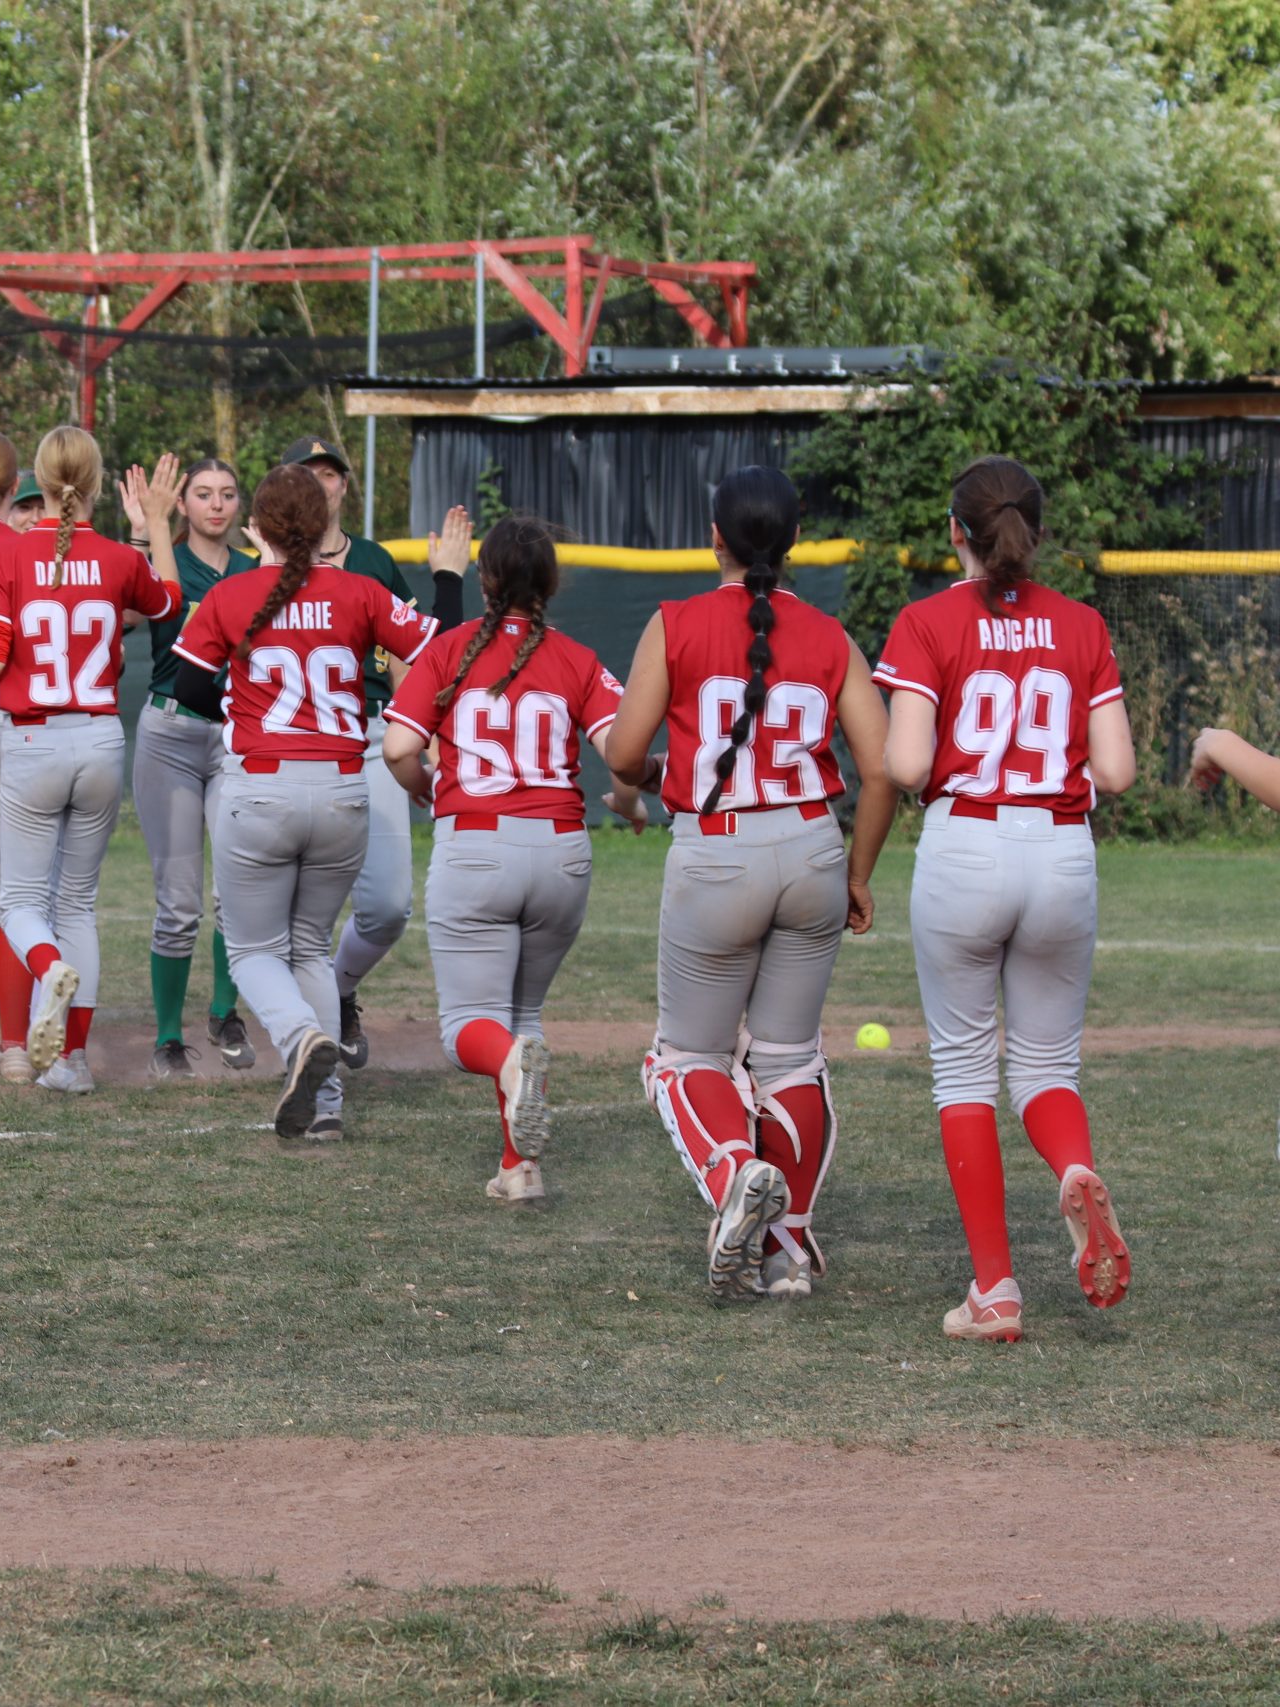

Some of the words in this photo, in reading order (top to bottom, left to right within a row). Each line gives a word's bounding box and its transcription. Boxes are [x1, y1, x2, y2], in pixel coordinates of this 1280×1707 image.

[35, 560, 102, 586] DAVINA
[272, 601, 333, 630] MARIE
[21, 599, 116, 706] 32
[978, 617, 1056, 652] ABIGAIL
[249, 645, 365, 742] 26
[454, 687, 573, 797] 60
[693, 675, 829, 814] 83
[942, 666, 1073, 797] 99
